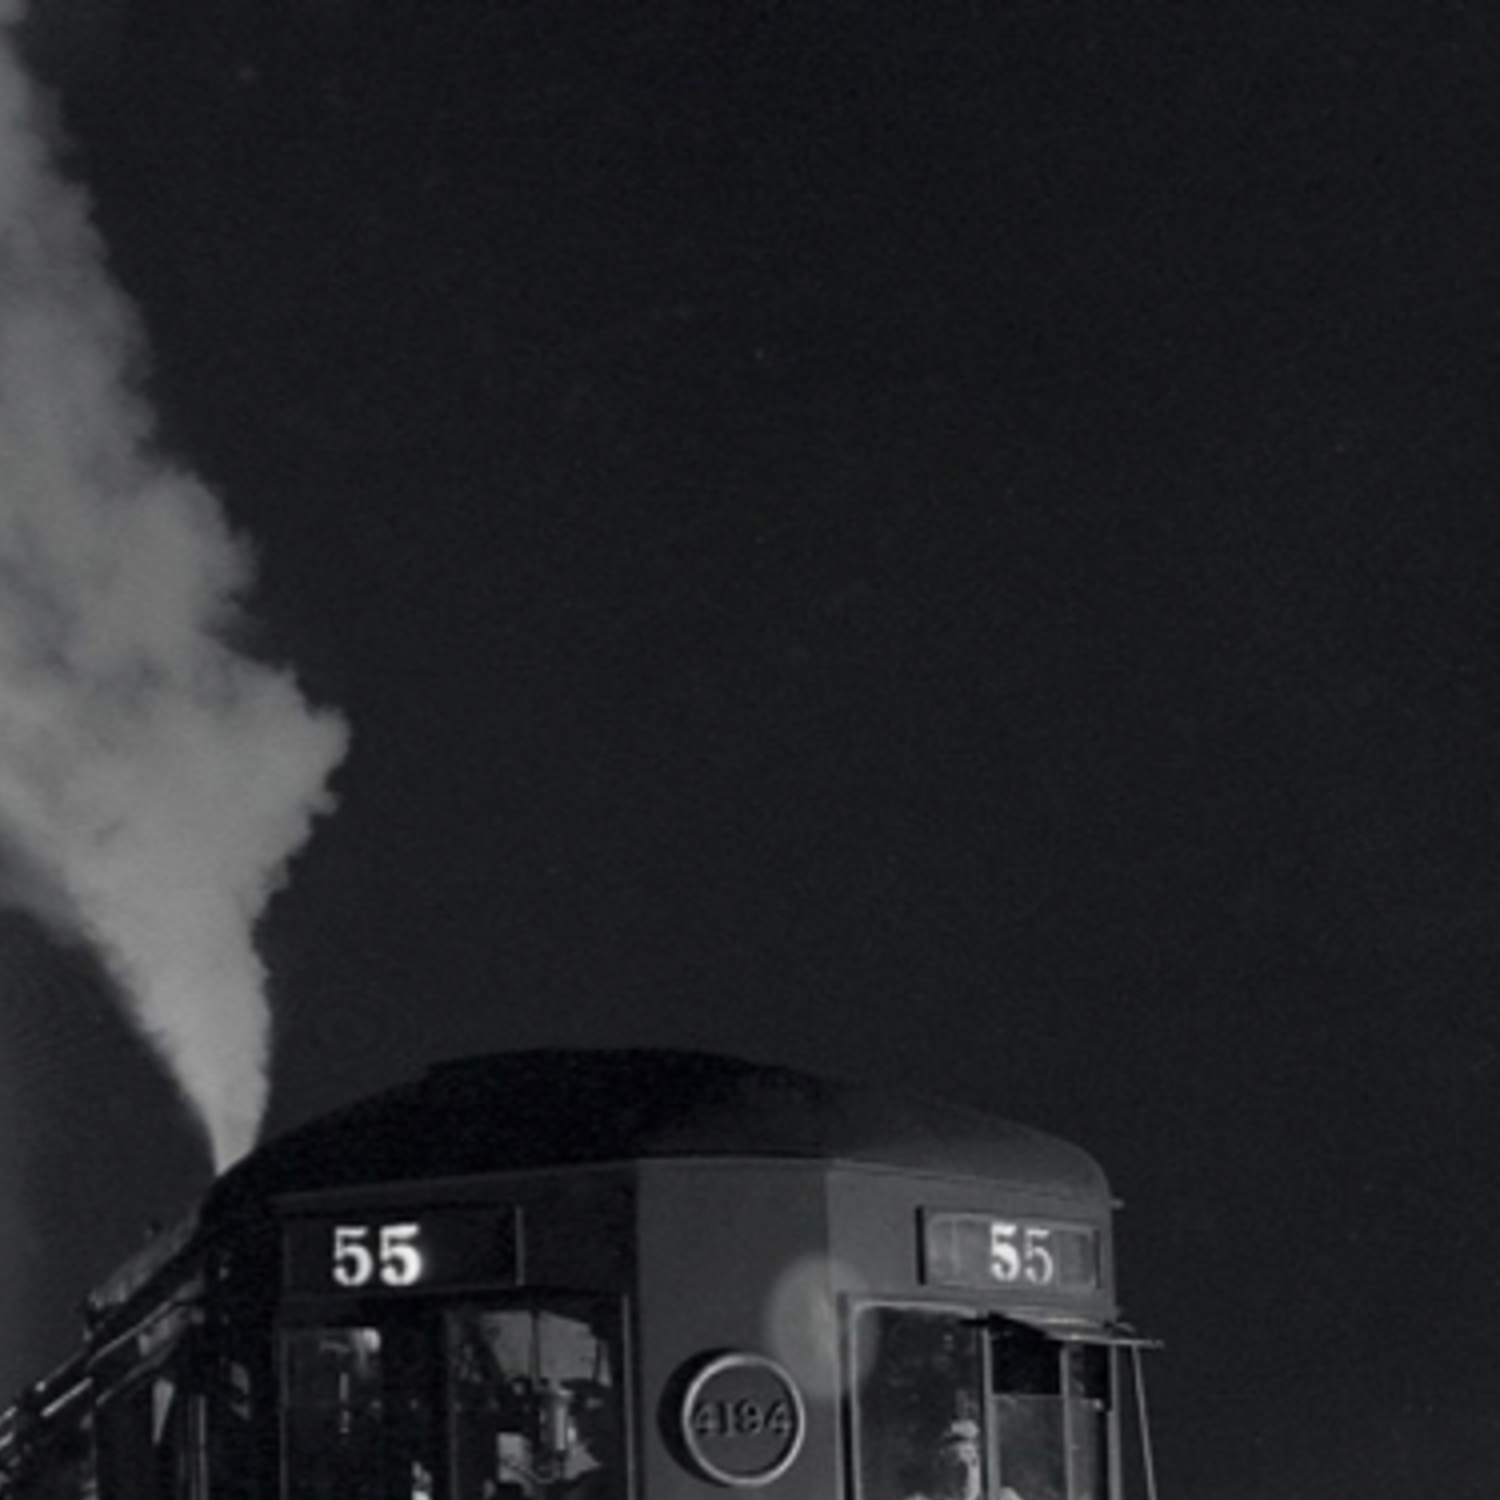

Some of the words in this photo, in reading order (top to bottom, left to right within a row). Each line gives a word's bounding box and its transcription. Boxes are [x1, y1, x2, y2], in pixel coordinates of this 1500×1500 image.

[333, 1223, 421, 1286] 55
[991, 1222, 1054, 1285] 55
[694, 1400, 791, 1438] 4194
